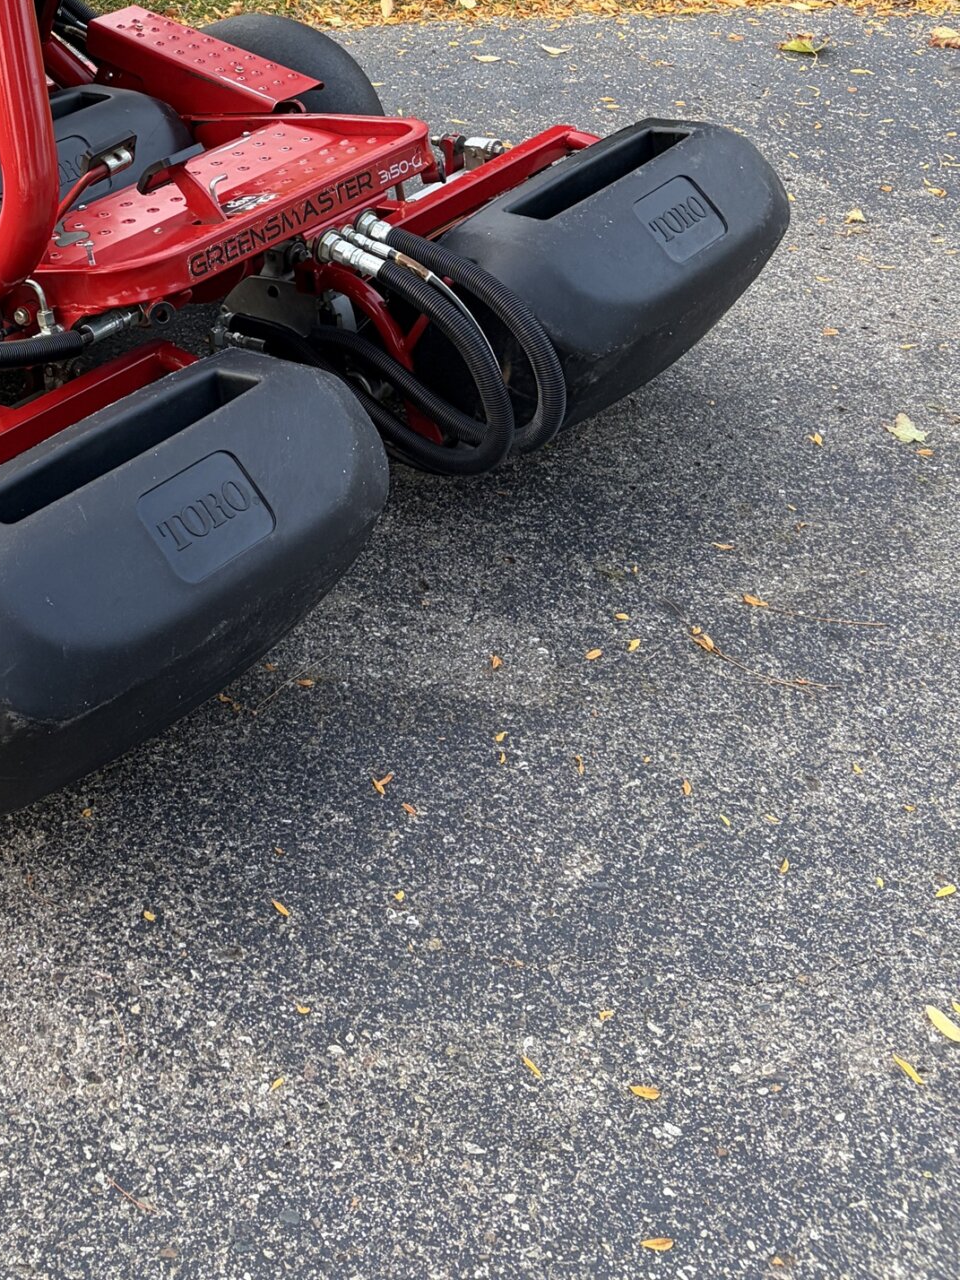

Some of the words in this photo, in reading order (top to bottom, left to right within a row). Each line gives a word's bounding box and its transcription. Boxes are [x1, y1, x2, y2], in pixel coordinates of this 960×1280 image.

[189, 170, 375, 278] GREENSMASTER
[378, 151, 422, 184] 3150-Q
[648, 195, 707, 242] TORO
[156, 480, 250, 552] TORO
